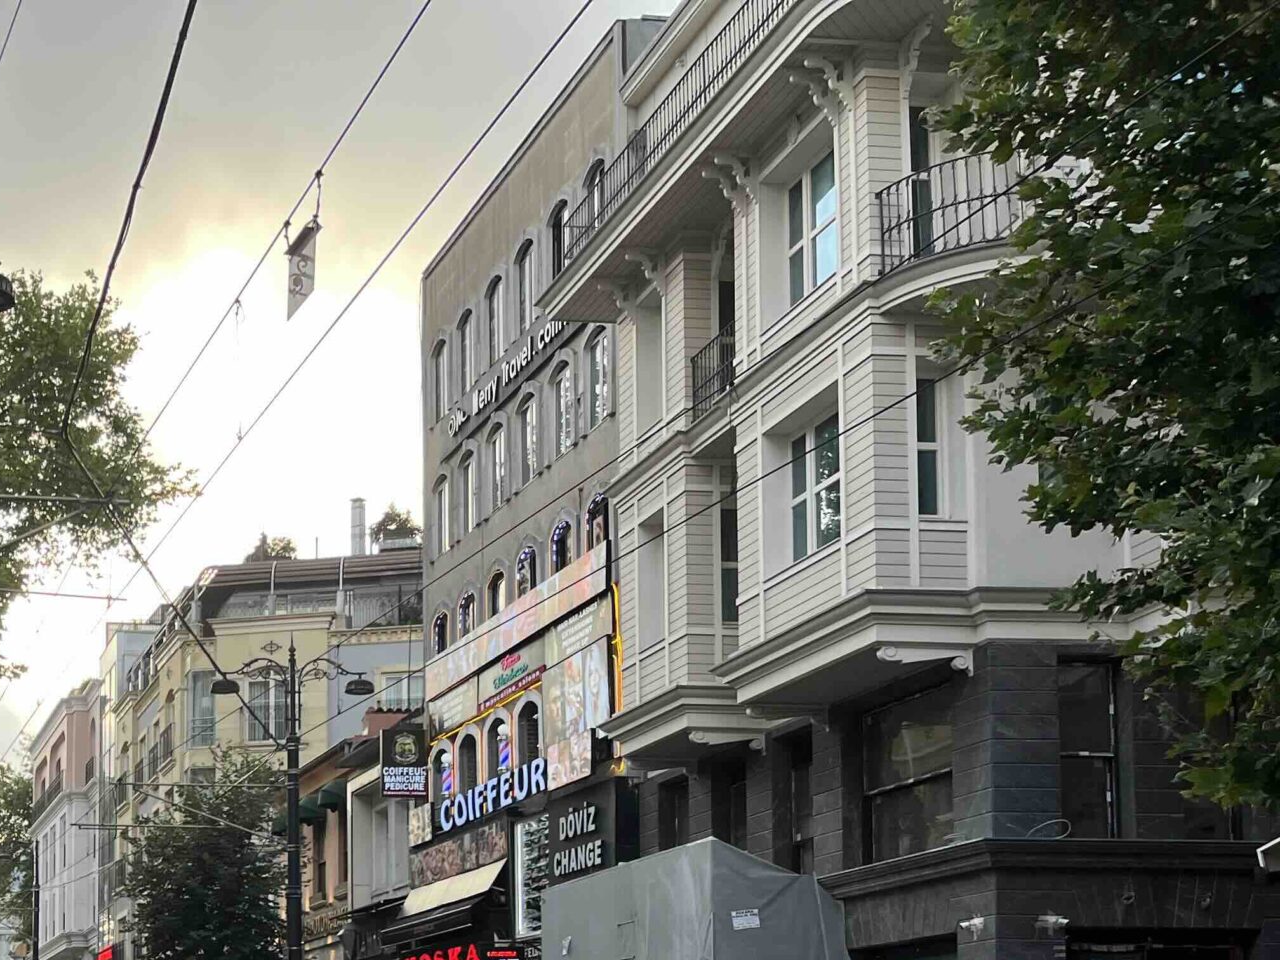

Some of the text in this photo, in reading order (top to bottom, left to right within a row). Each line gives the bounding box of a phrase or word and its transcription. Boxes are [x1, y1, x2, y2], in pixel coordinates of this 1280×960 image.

[472, 375, 498, 416] Merry
[383, 766, 427, 776] COIFFEUR
[440, 757, 546, 832] COIFFEUR
[559, 801, 596, 841] DÖVİZ
[553, 839, 602, 877] CHANGE
